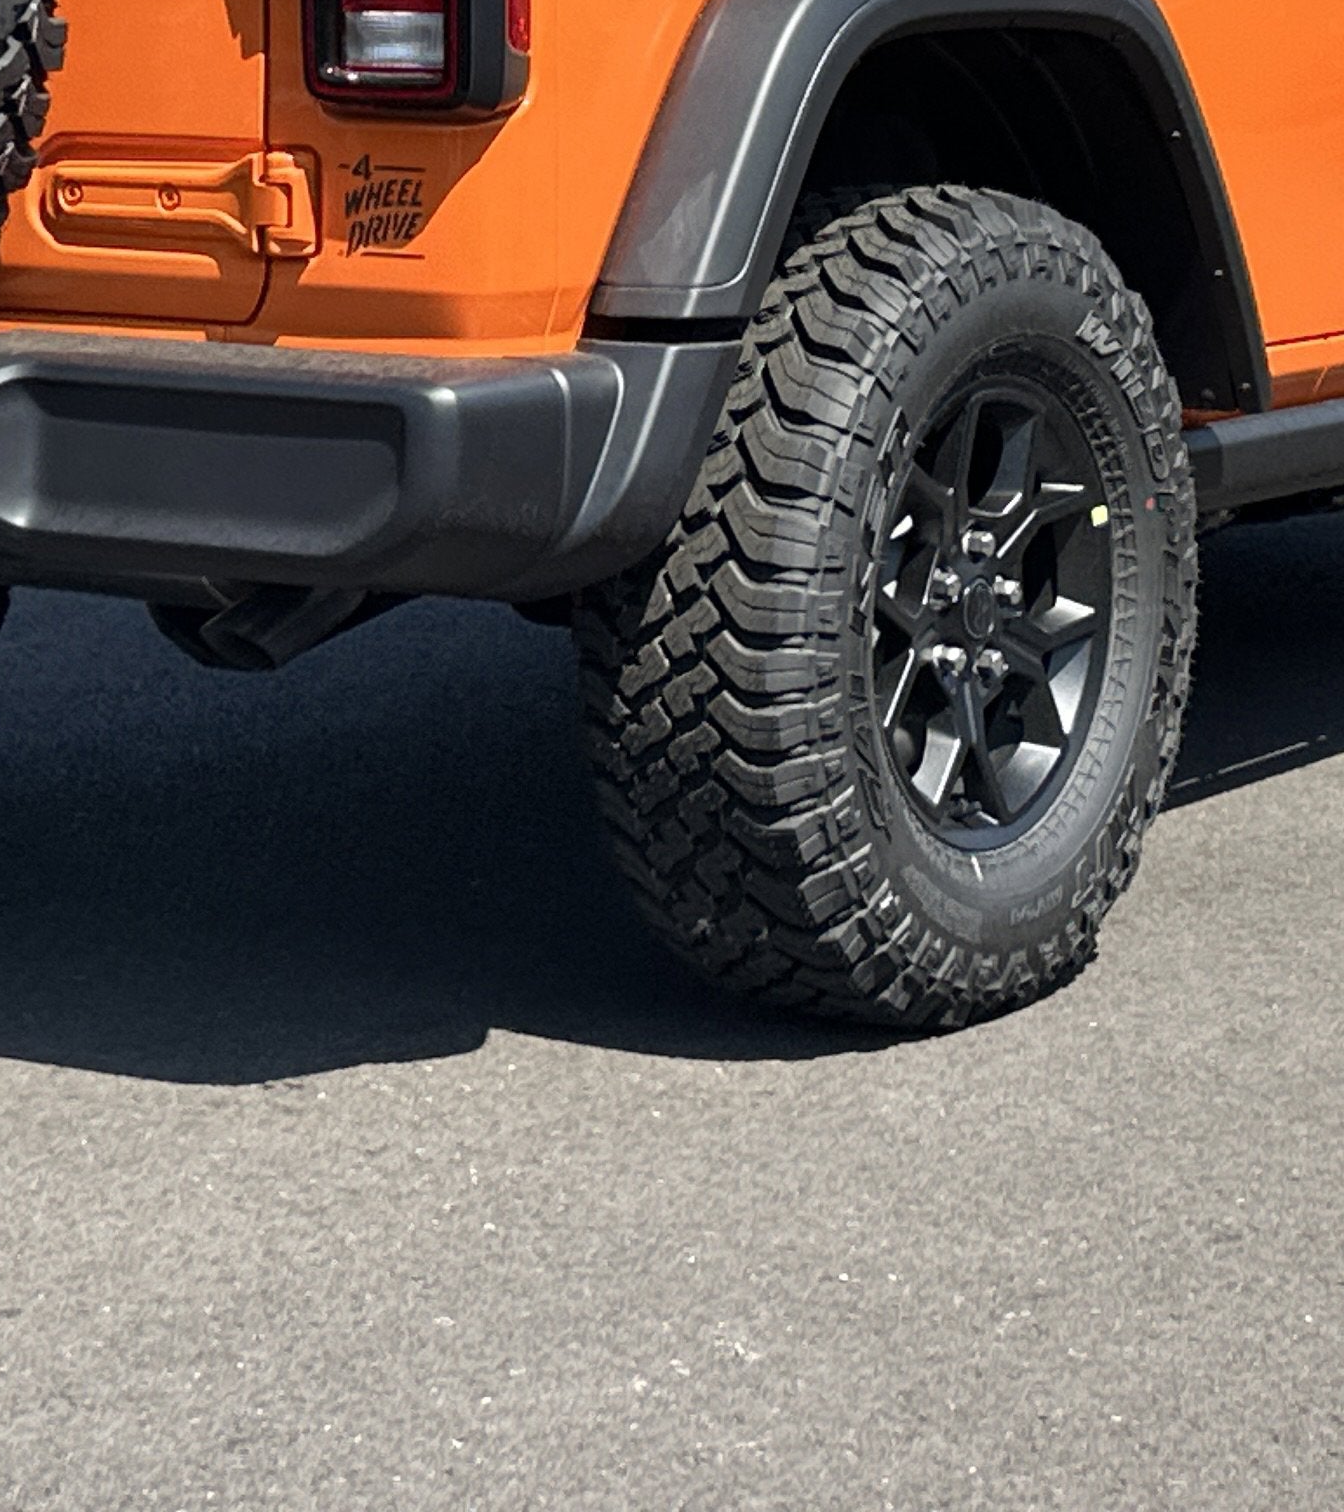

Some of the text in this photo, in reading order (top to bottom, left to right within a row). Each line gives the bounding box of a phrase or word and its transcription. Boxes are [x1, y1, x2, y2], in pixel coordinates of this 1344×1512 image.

[351, 154, 371, 180] 4
[344, 179, 423, 219] WHEEL
[345, 212, 423, 258] DRIVE
